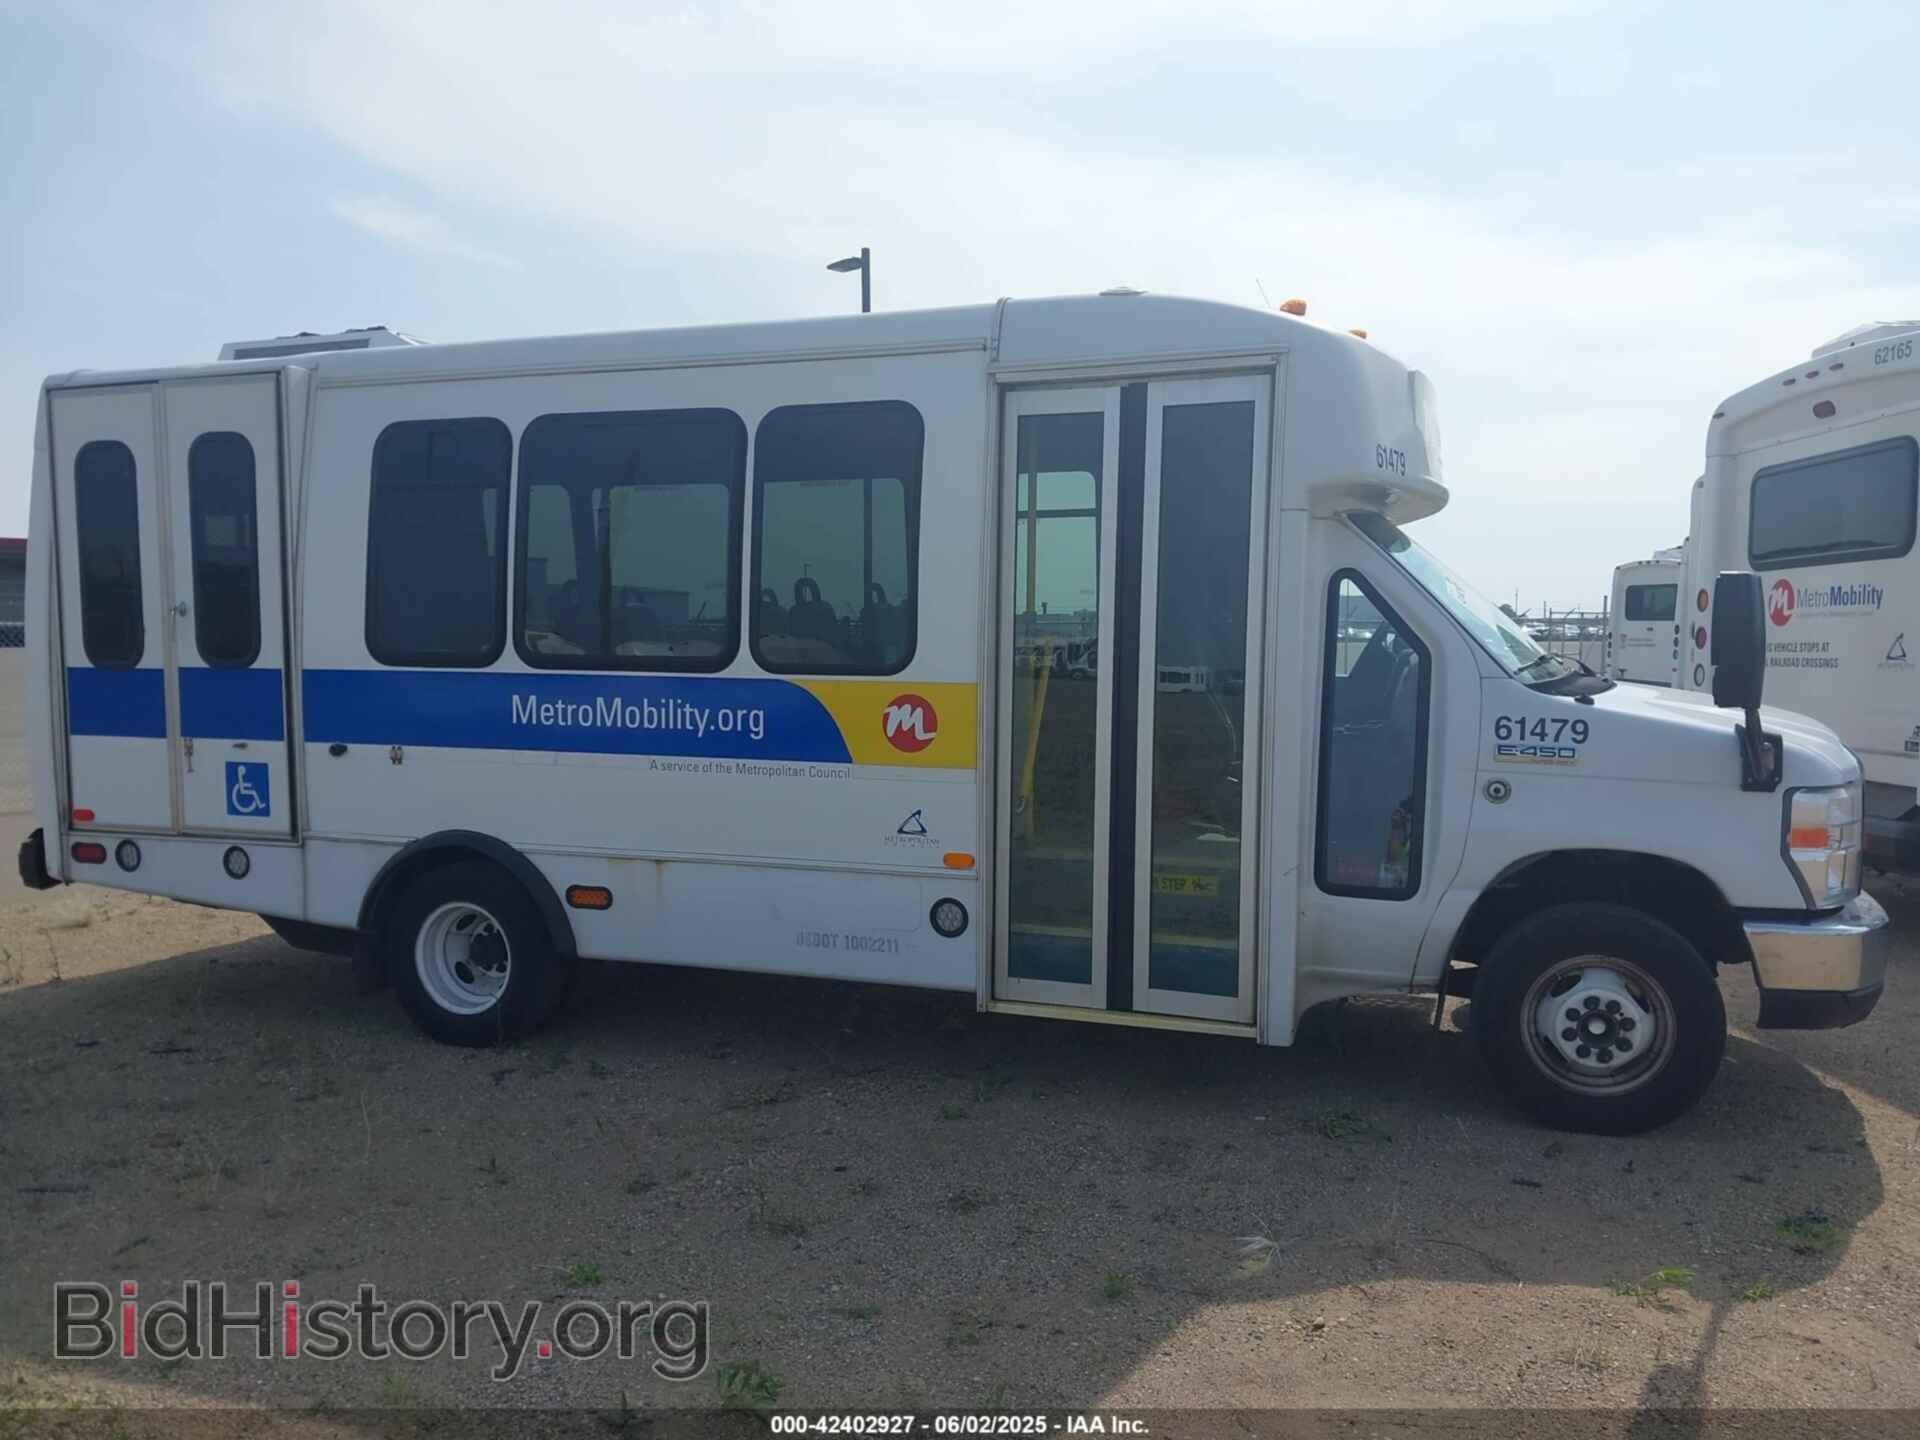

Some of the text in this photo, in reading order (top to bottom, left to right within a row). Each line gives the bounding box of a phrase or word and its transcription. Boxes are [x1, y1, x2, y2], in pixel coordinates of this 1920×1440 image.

[1873, 340, 1913, 366] 62165
[1376, 443, 1406, 477] 61479
[1797, 584, 1884, 609] MetroMobility
[1774, 642, 1798, 653] VEHICLE
[1799, 641, 1820, 652] STOPS
[1821, 641, 1831, 652] AT
[1770, 657, 1839, 668] RAILROAD CROSSINGS
[511, 694, 765, 740] MetroMobility.org
[1494, 716, 1590, 744] 61479
[1496, 745, 1576, 758] E-450
[650, 759, 851, 780] A service of the Metropolitan Council
